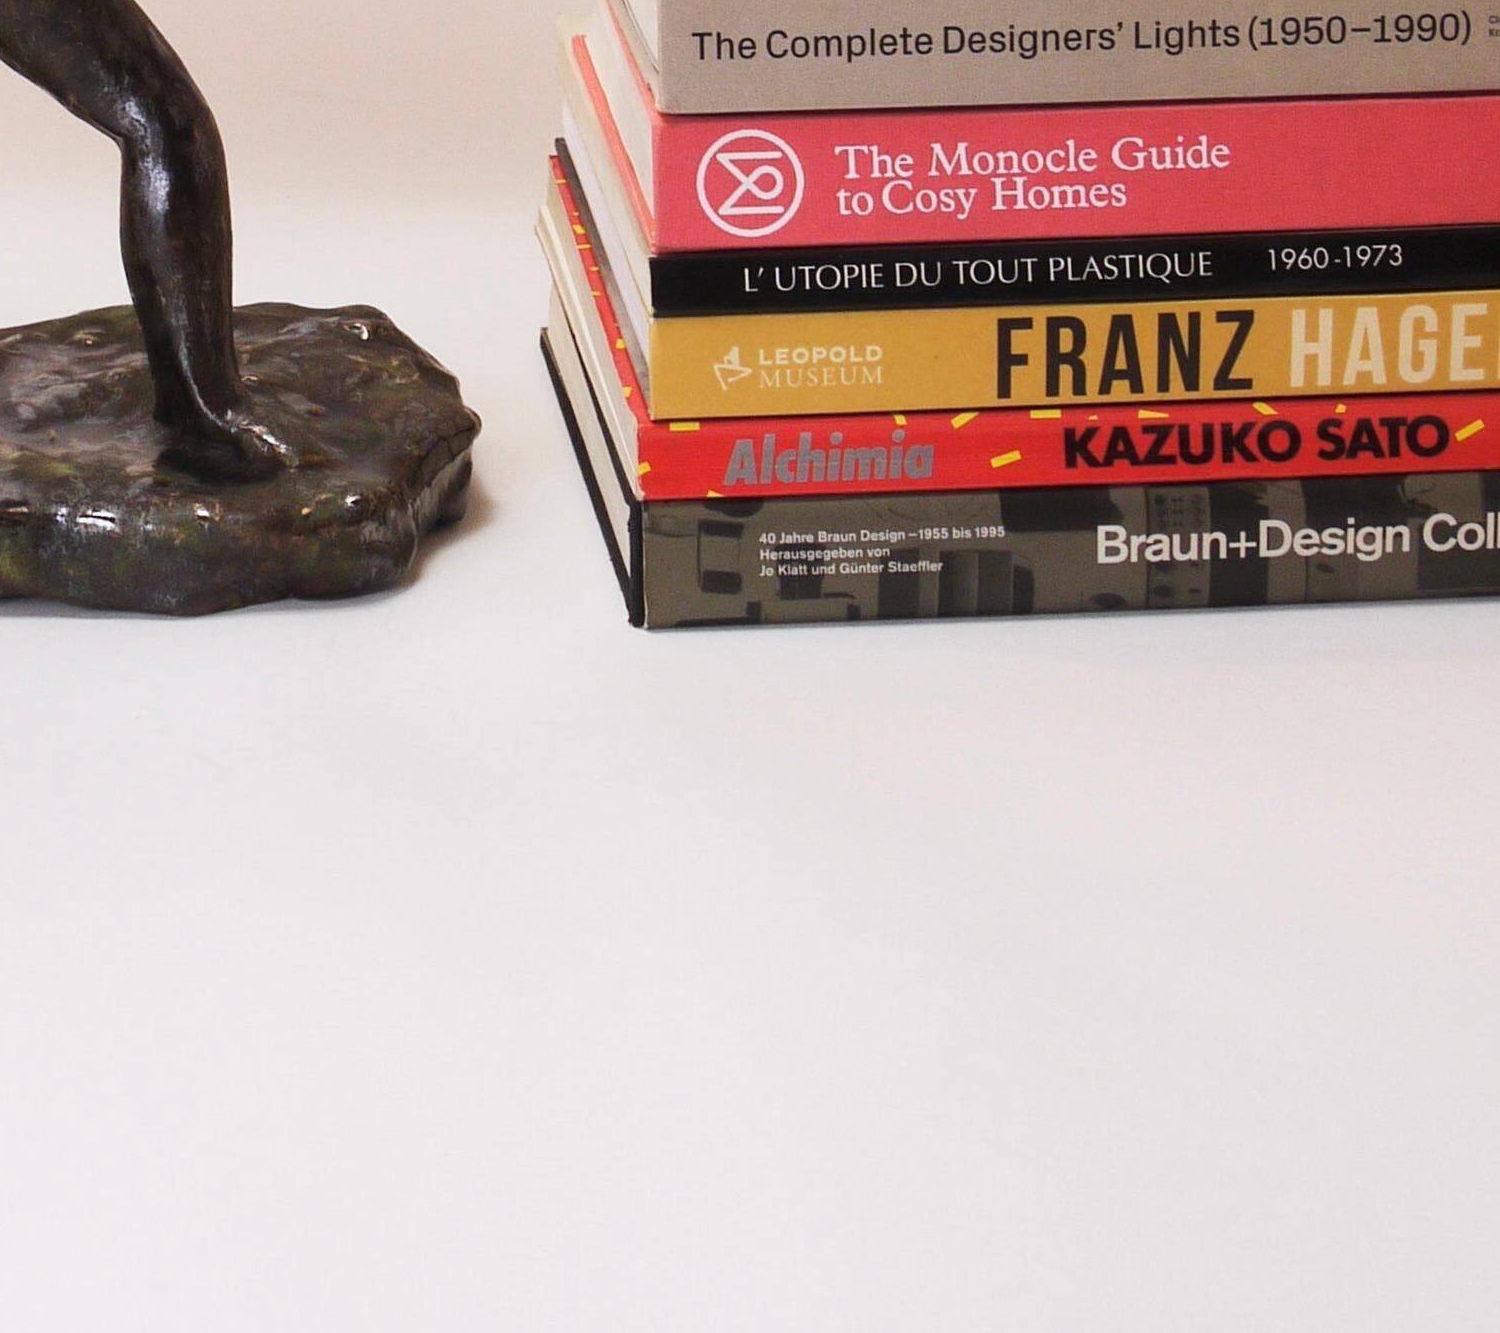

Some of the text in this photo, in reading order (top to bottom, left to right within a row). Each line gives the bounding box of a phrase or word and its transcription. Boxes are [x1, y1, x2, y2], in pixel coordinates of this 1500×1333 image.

[692, 9, 1472, 63] The Complete Designers' Lights (1950–1990)
[834, 135, 1231, 180] The Monocle Guide
[835, 175, 1127, 221] to Cosy Homes
[895, 259, 942, 287] DU
[951, 256, 1040, 285] TOUT
[1048, 250, 1214, 283] PLASTIQUE
[1267, 243, 1404, 272] 1960-1973
[758, 345, 884, 366] LEOPOLD
[996, 302, 1500, 401] FRANZ HAGE
[758, 365, 884, 389] MUSEUM
[723, 428, 935, 487] Alchimia
[1062, 414, 1451, 470] KAZUKO SATO
[759, 533, 776, 545] 40
[779, 531, 814, 544] Jahre
[818, 530, 856, 543] Braun
[860, 529, 905, 544] Design
[952, 527, 971, 539] bis
[974, 526, 1005, 538] 1995
[759, 548, 890, 561] Herausgegeben von
[1097, 517, 1410, 564] Braun+Design
[759, 560, 943, 577] Jo Klatt und Günter Staeffler
